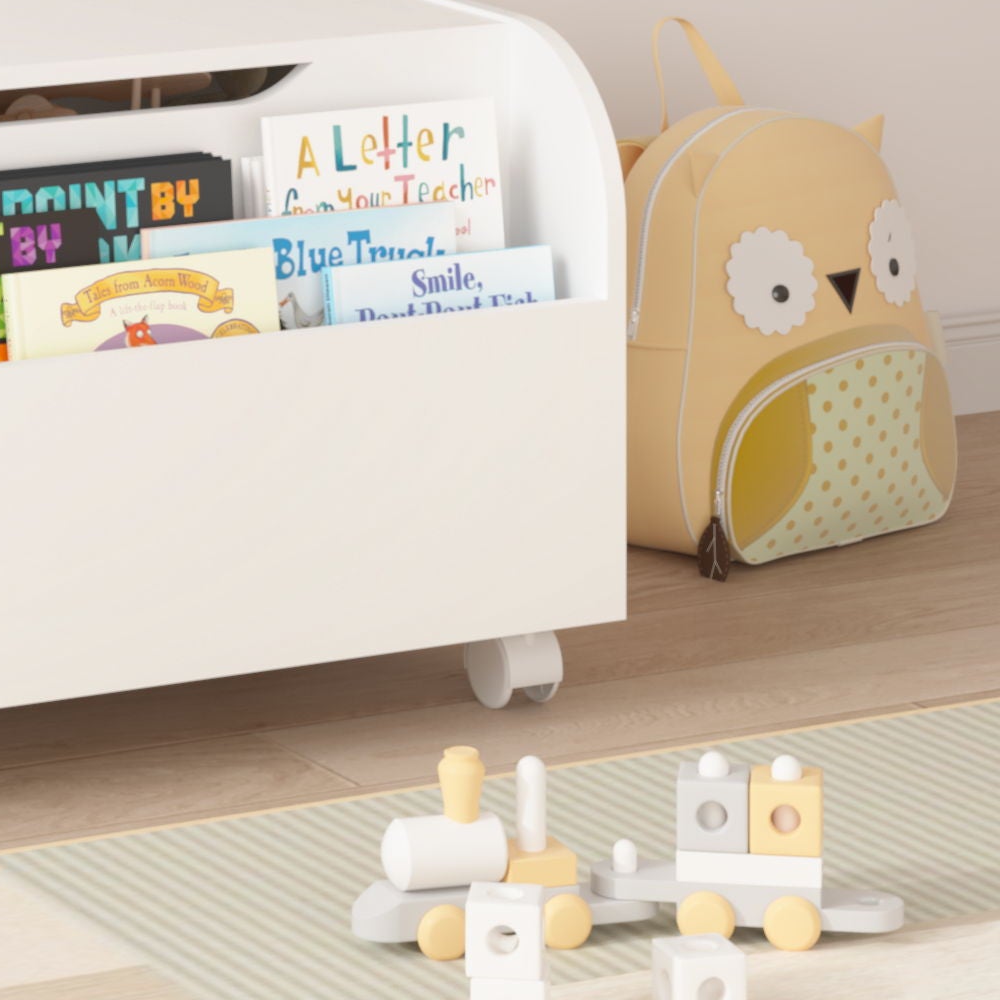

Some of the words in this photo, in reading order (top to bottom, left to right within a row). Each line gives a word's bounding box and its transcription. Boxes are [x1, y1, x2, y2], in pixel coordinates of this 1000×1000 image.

[296, 135, 320, 179] A
[332, 114, 465, 172] Letter
[150, 178, 200, 221] BY
[394, 163, 496, 204] Teacher
[10, 223, 62, 267] BY
[272, 238, 344, 280] Blue
[83, 286, 111, 303] Tales
[113, 280, 140, 294] from
[143, 273, 176, 288] Acorn
[177, 272, 209, 293] Wood
[411, 263, 483, 298] Smile,
